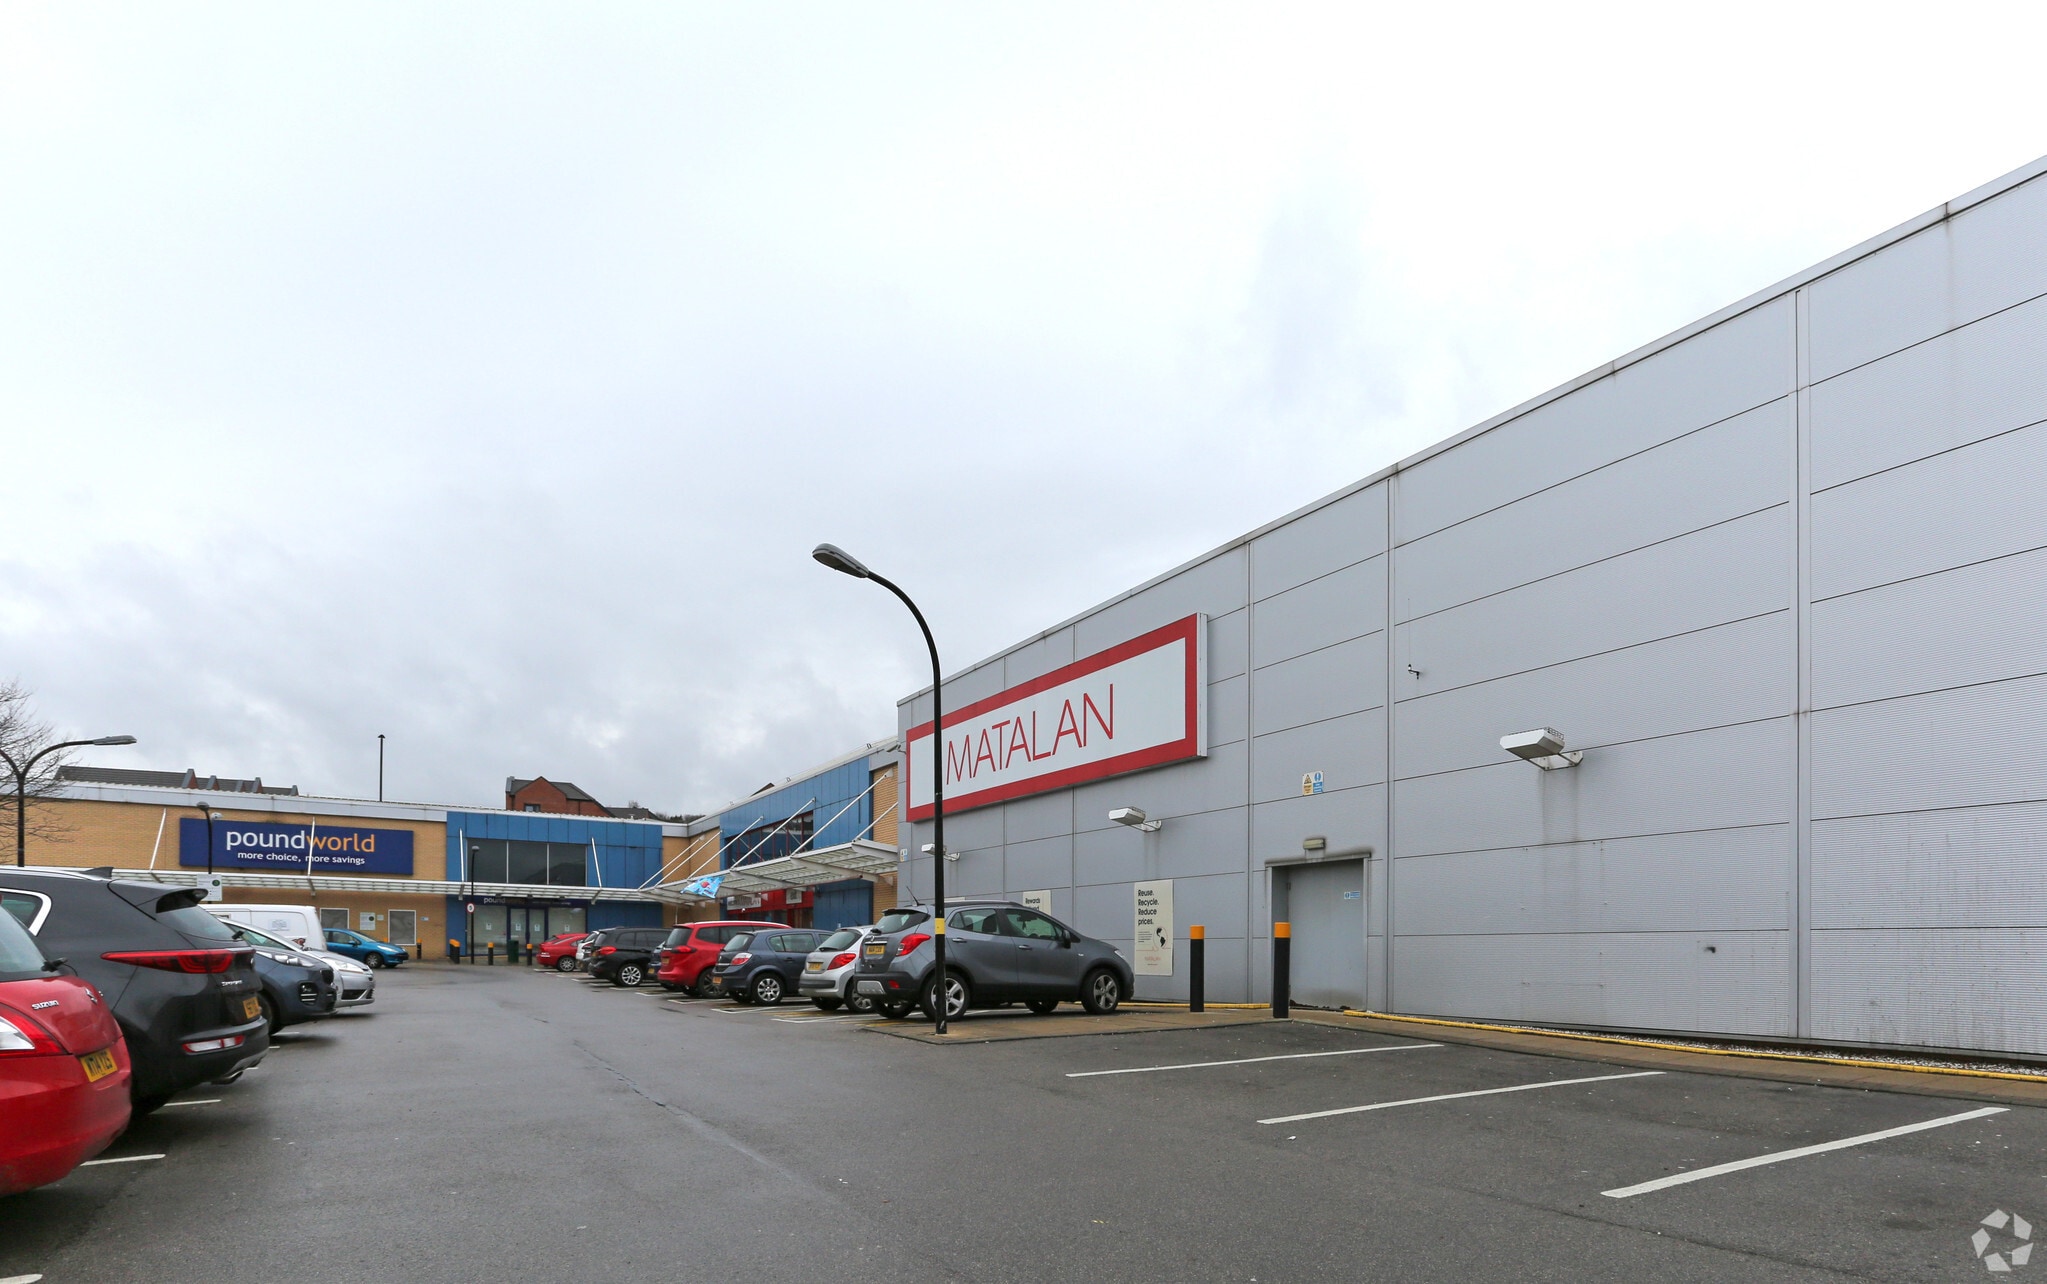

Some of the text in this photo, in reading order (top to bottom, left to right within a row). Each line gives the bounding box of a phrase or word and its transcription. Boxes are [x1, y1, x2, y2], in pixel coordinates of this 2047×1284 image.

[946, 683, 1114, 785] MATALAN
[226, 829, 375, 853] poundworld
[237, 851, 264, 860] more
[266, 852, 301, 863] choice,
[332, 856, 366, 865] savings
[1137, 889, 1154, 897] Reuse.
[1137, 898, 1159, 907] Recycle.
[1137, 908, 1158, 916] Reduce
[1137, 918, 1154, 926] prices.
